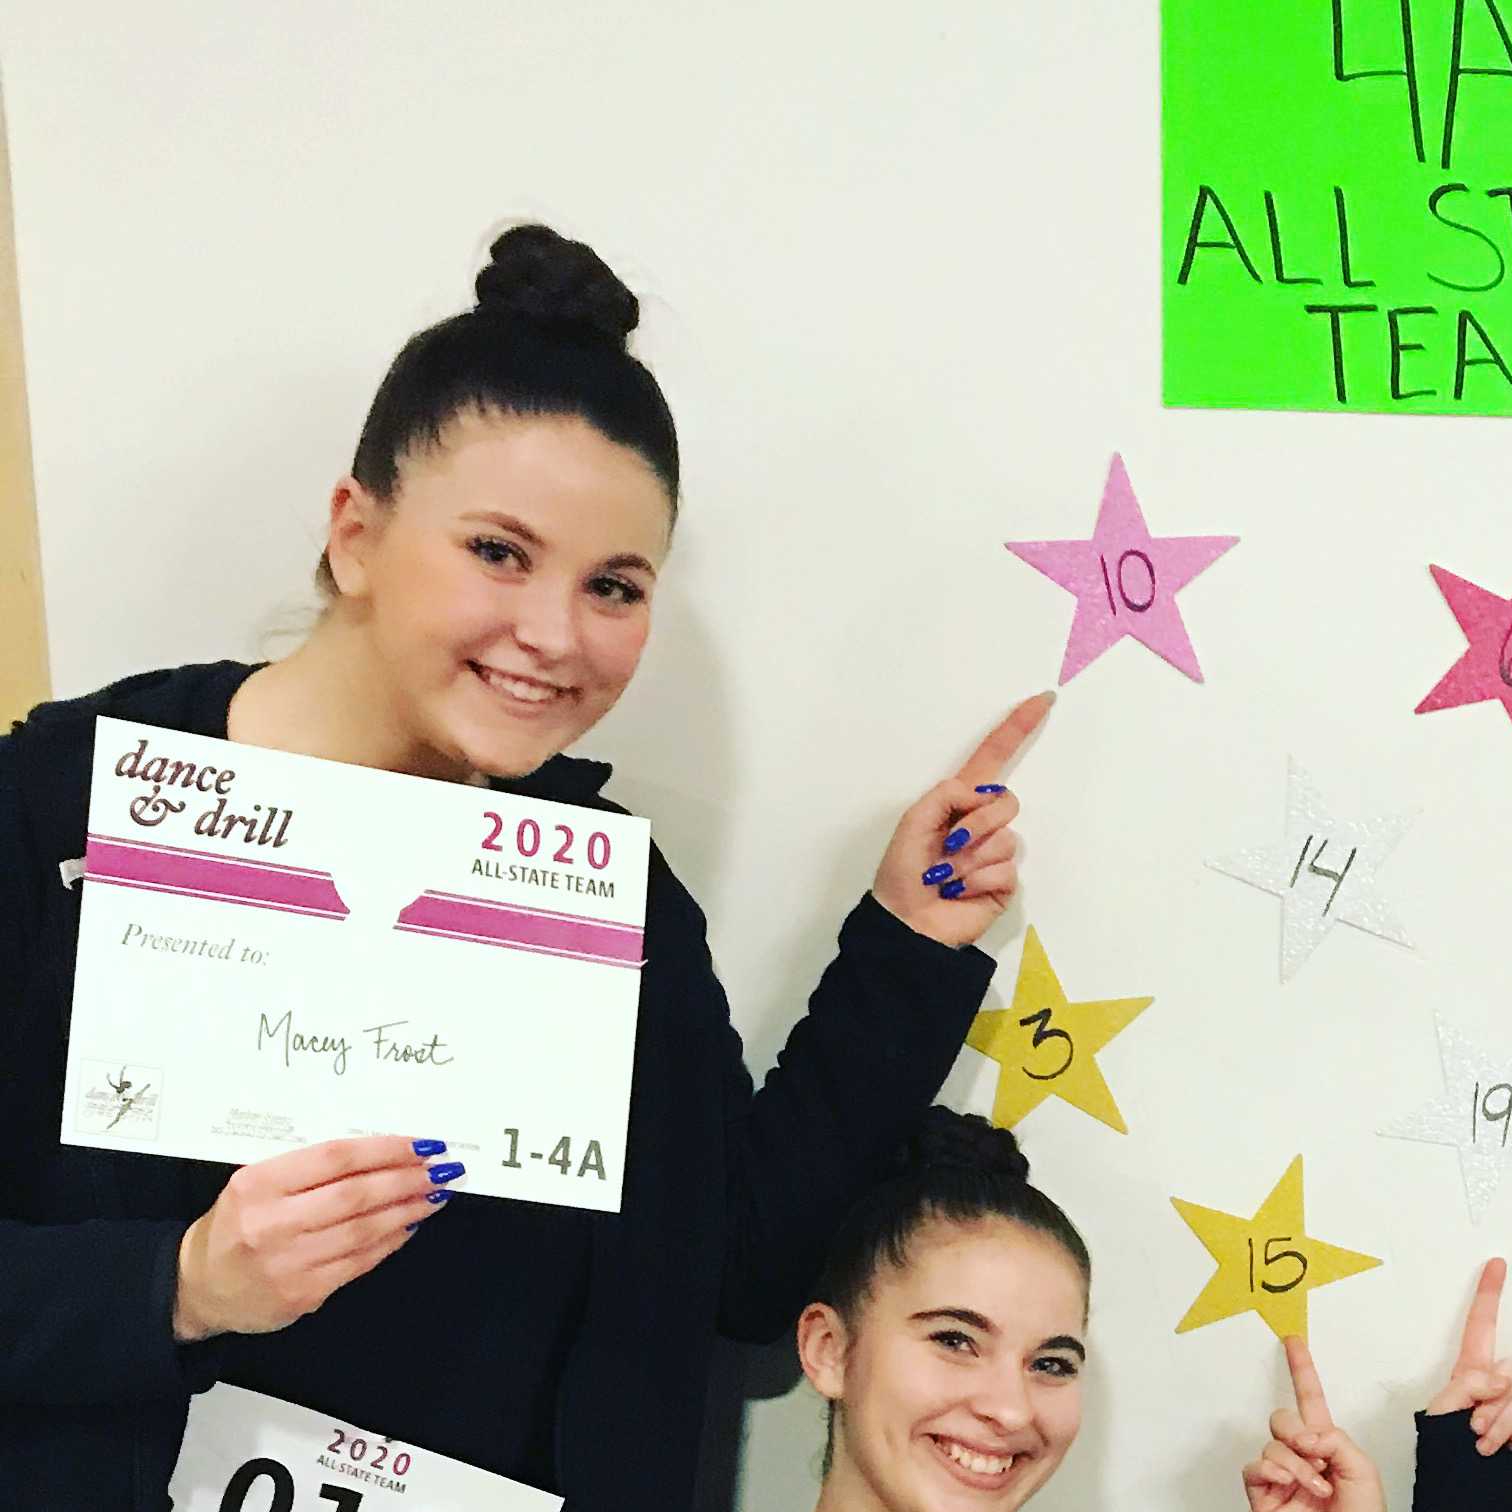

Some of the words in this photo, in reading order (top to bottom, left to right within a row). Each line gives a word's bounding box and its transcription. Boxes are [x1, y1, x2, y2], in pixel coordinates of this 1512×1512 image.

[1177, 184, 1376, 285] ALL
[1100, 549, 1157, 616] 10
[115, 738, 236, 794] dance
[130, 785, 186, 826] &
[194, 798, 293, 848] drill
[481, 811, 612, 869] 2020
[471, 859, 560, 890] ALL-STATE
[565, 871, 616, 899] TEAM
[1289, 834, 1357, 917] 14
[121, 923, 234, 961] Presented
[240, 945, 271, 966] to:
[257, 1010, 352, 1075] Macey
[362, 1020, 454, 1066] Frost
[1018, 1007, 1074, 1081] 3
[500, 1127, 607, 1181] 1-4A
[1248, 1237, 1307, 1293] 15
[327, 1429, 412, 1476] 2020
[373, 1473, 407, 1494] TEAM
